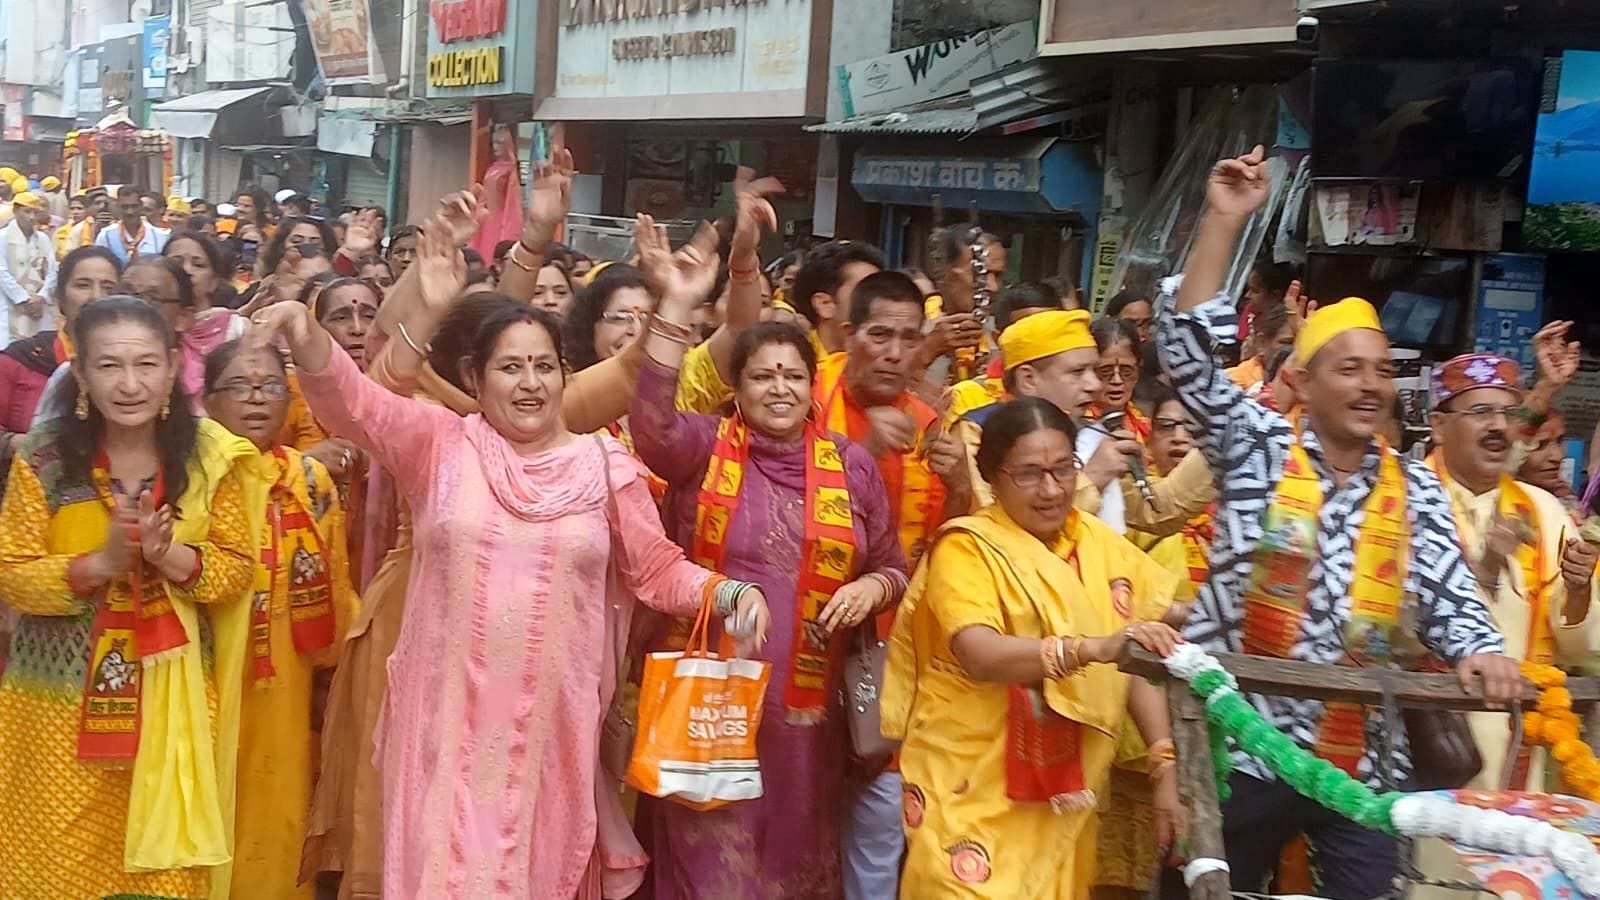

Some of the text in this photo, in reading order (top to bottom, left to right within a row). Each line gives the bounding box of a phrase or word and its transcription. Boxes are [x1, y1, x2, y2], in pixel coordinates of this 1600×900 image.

[426, 47, 502, 88] COLLECTION
[689, 704, 748, 721] MAXUM
[687, 720, 749, 739] SAGS
